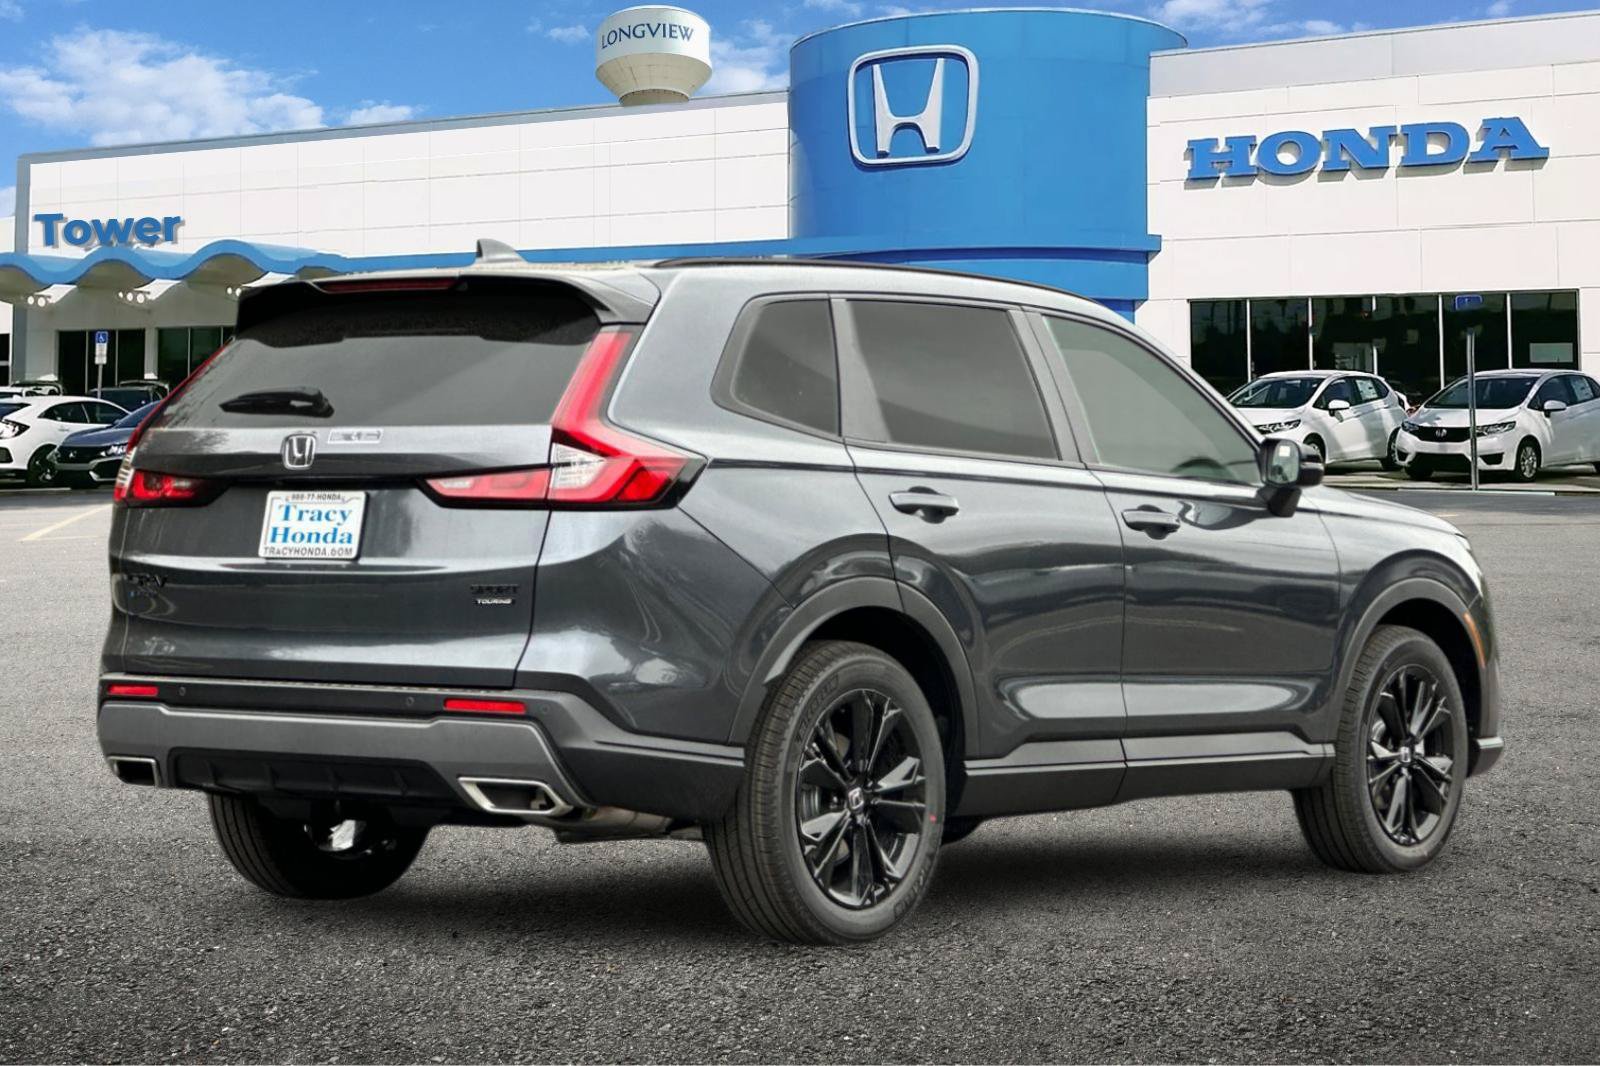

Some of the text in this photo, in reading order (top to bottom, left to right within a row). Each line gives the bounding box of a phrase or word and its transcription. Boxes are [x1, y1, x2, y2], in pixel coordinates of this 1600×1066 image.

[601, 23, 694, 49] LONGVIEW
[1186, 116, 1550, 180] HONDA
[34, 213, 183, 246] Tower
[278, 504, 352, 526] Tracy
[270, 526, 353, 544] Honda
